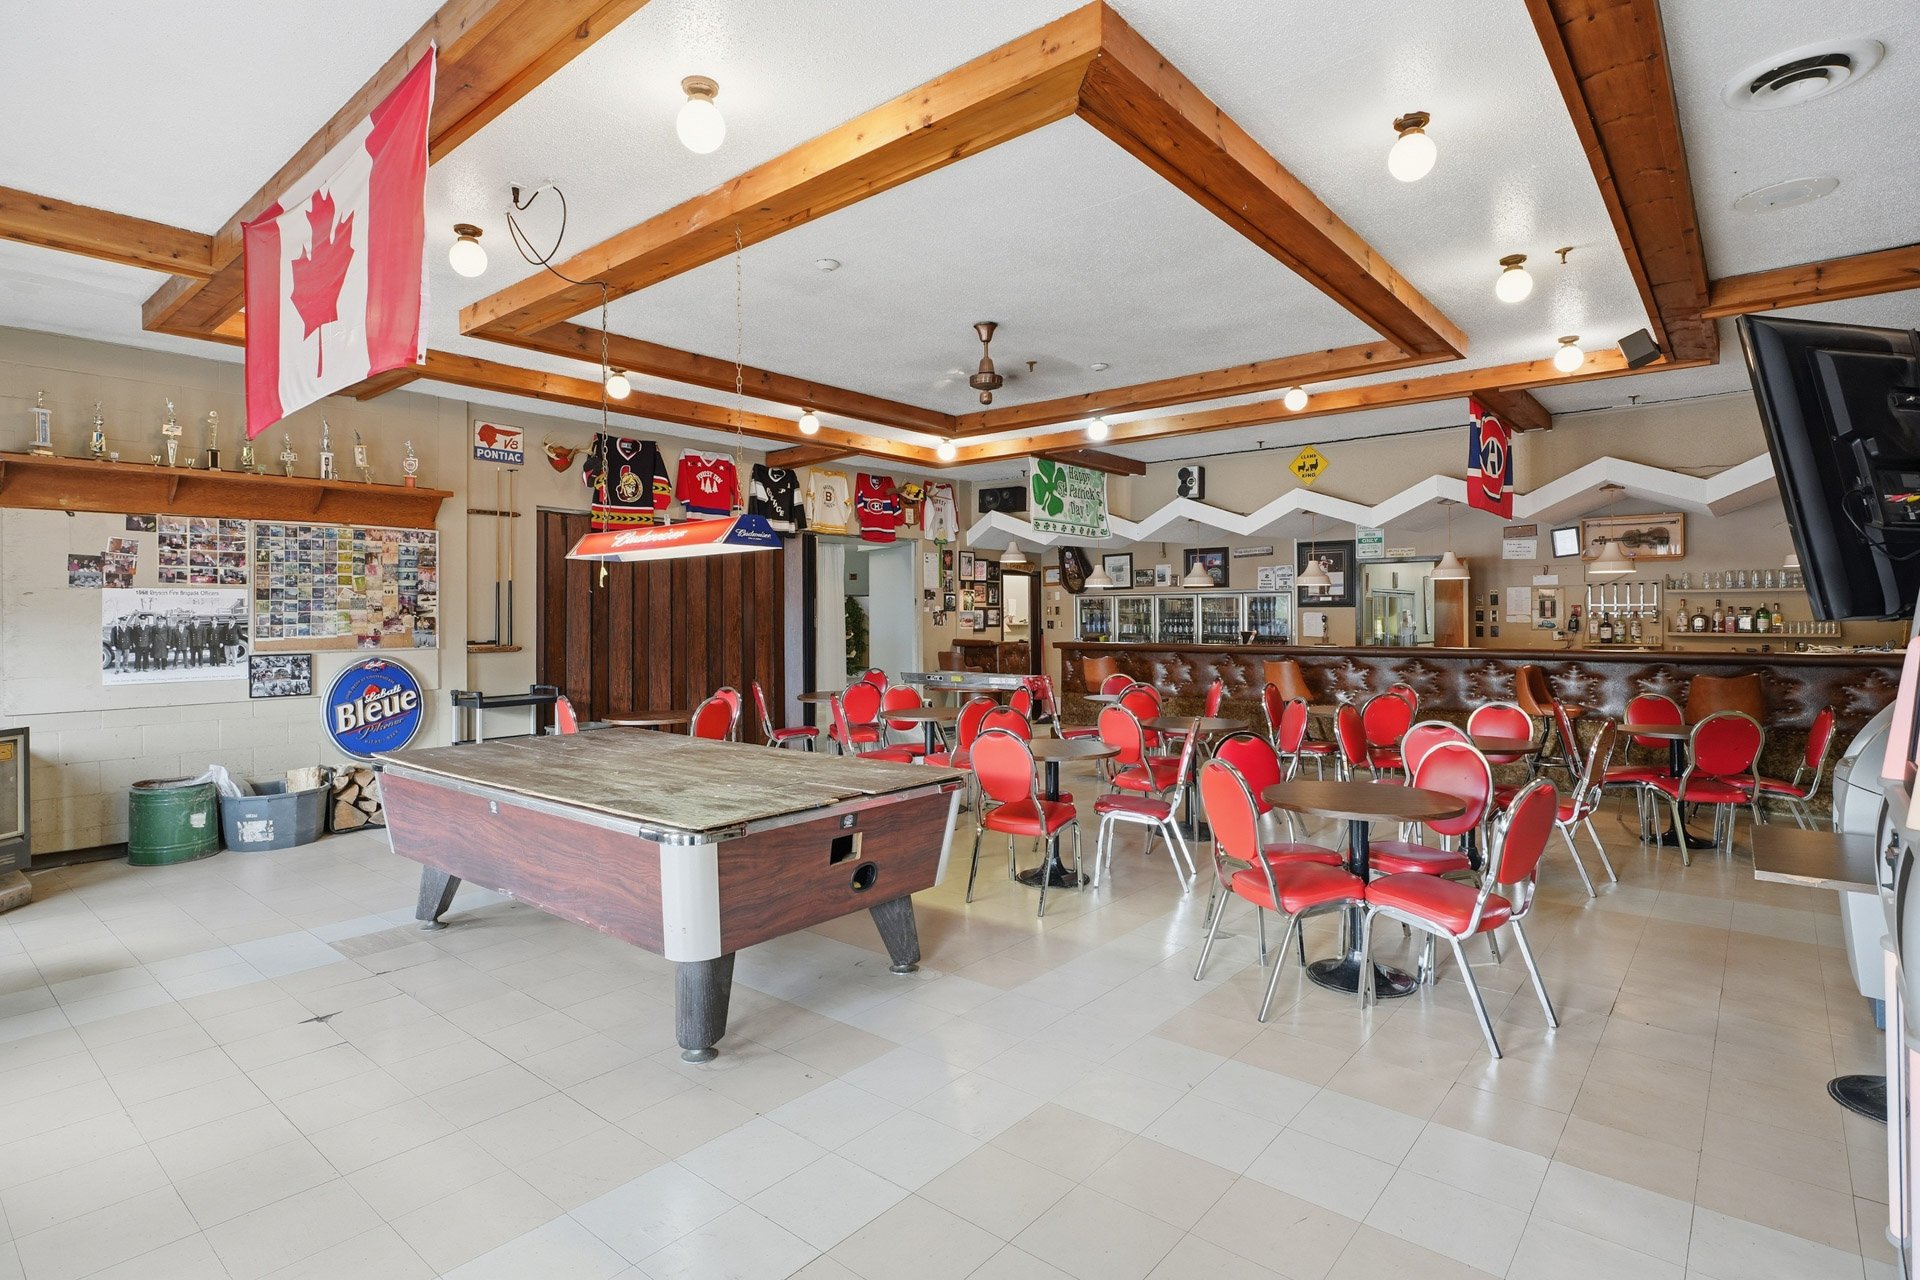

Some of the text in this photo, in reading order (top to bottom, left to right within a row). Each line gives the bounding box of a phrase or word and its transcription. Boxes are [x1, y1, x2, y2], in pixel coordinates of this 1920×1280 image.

[504, 438, 519, 450] V8
[476, 448, 522, 463] PONTIAC
[1068, 466, 1091, 486] Happy
[825, 491, 833, 502] B
[1069, 484, 1101, 501] Patrick's
[611, 529, 688, 547] Budweiser
[735, 528, 772, 538] Budweiser
[365, 684, 402, 703] Labatt
[335, 689, 418, 735] Bleue
